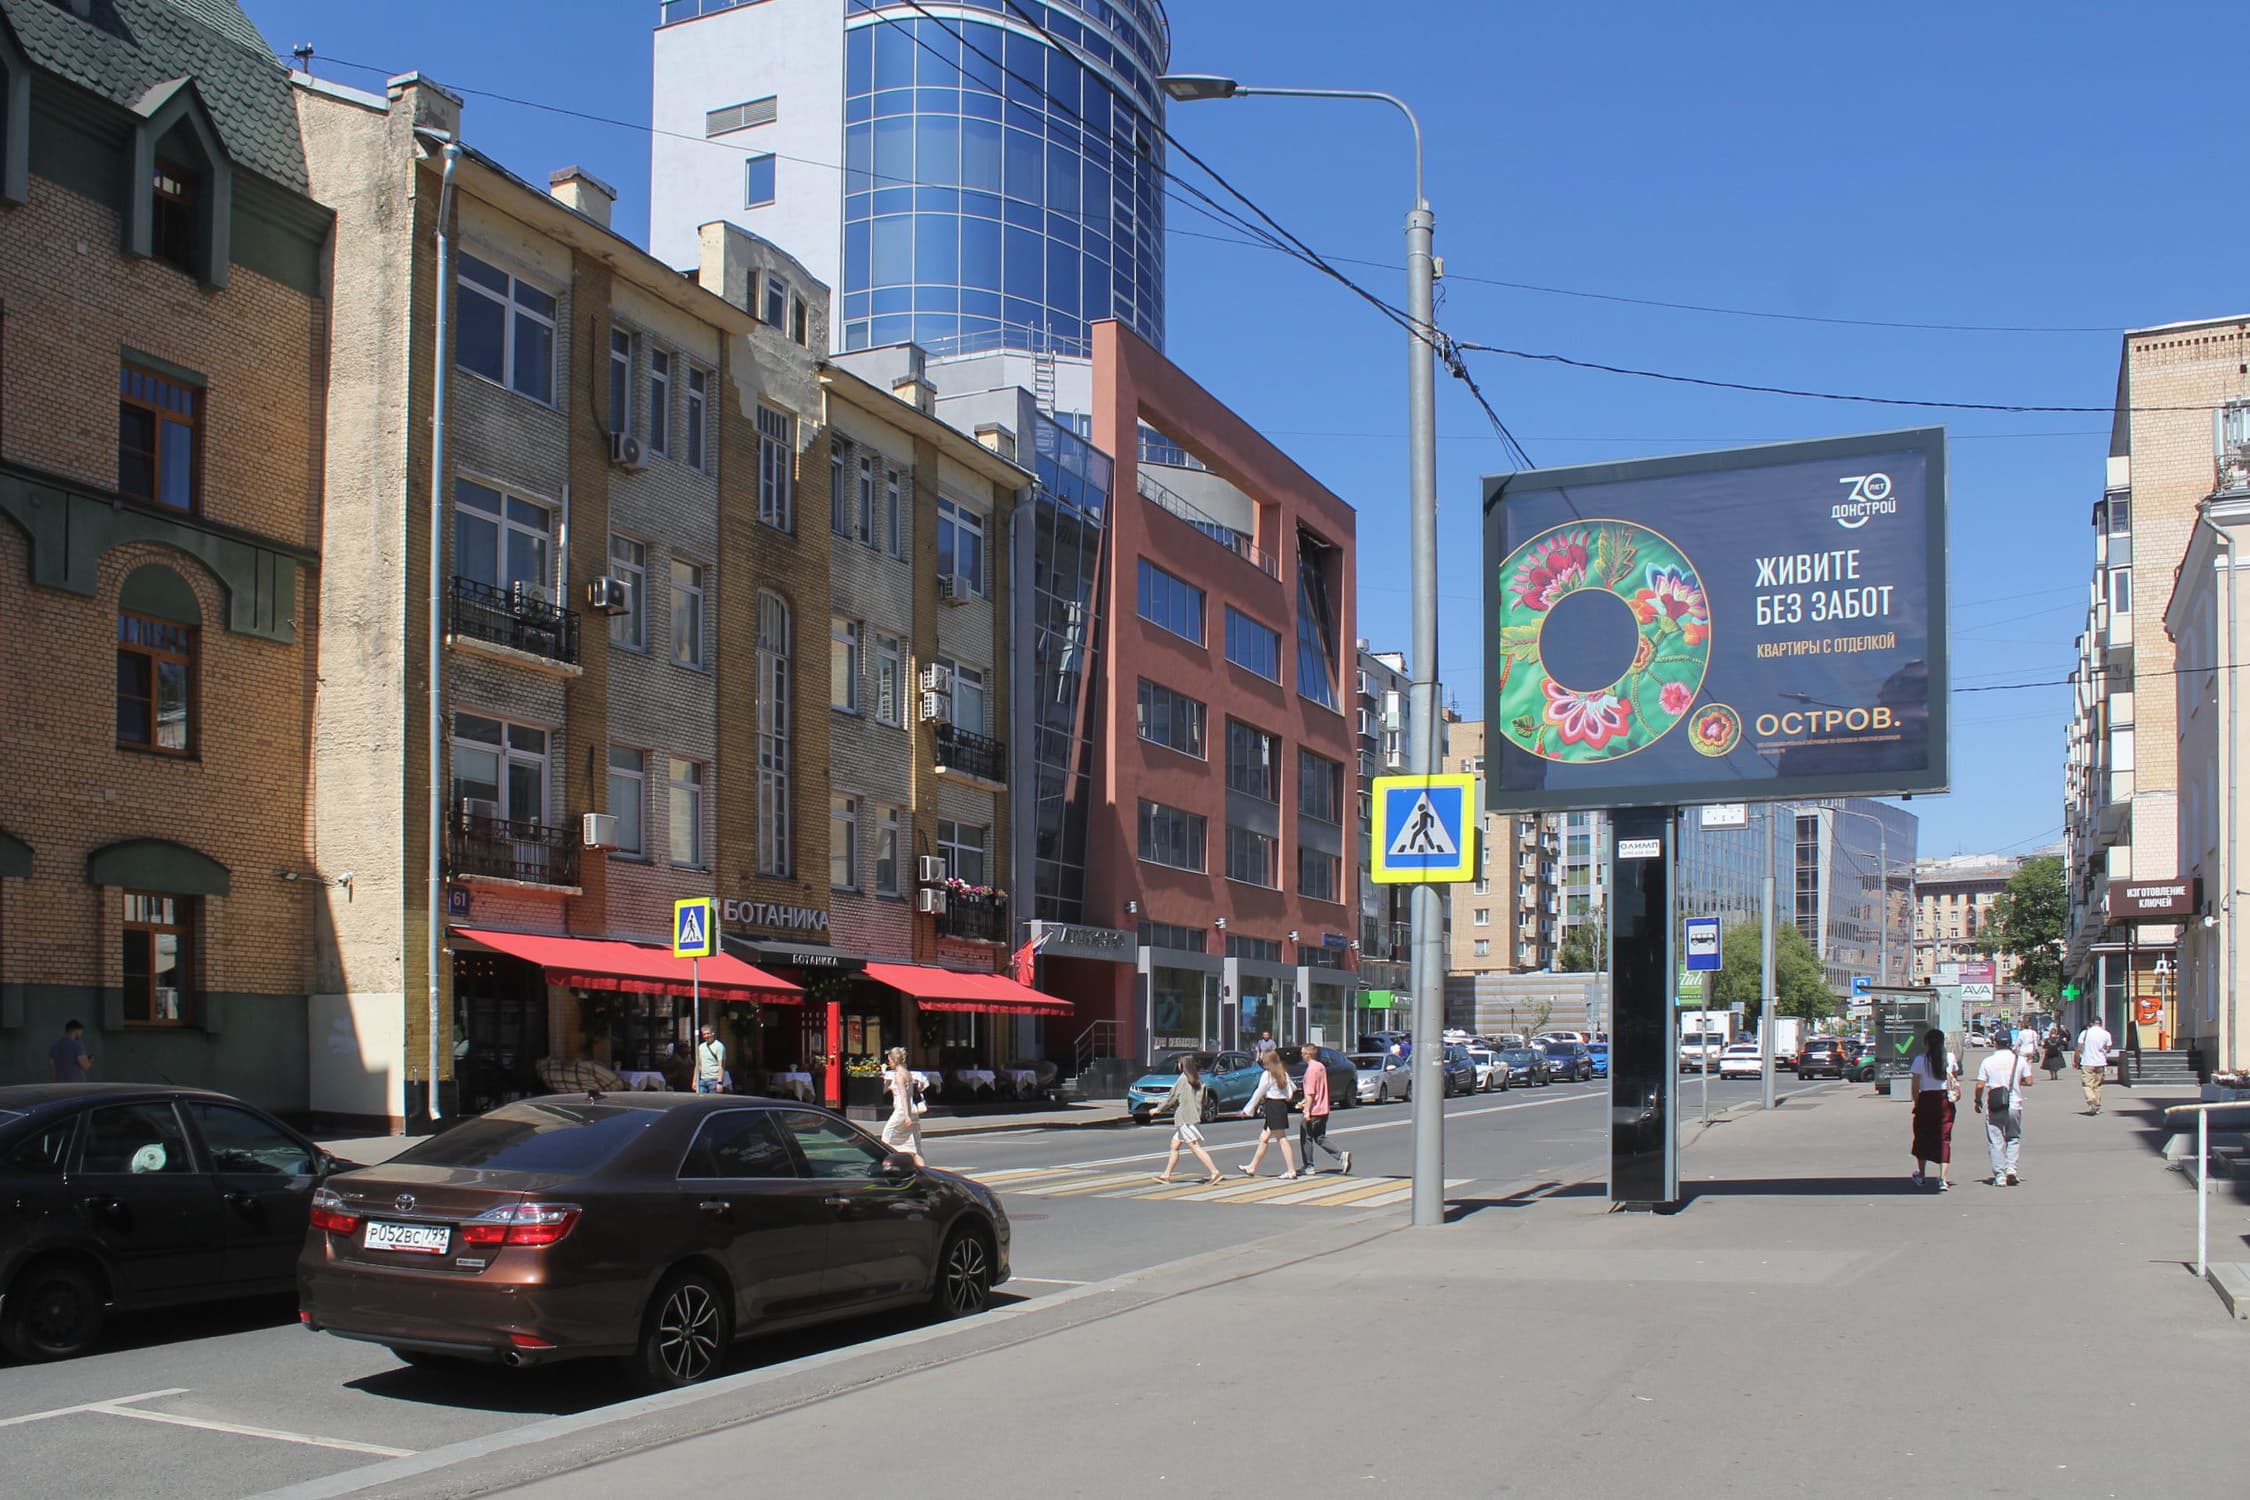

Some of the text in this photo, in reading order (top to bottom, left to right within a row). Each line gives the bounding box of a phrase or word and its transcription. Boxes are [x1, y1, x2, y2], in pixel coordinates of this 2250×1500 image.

[1830, 496, 1897, 519] ДОНСТРОЙ
[1754, 549, 1860, 588] ЖИВИТЕ
[1756, 585, 1894, 627] БЕЗ ЗАБОТ
[1756, 631, 1896, 659] КВАРТИРЫ С ОТДЕЛКОЙ
[1755, 706, 1901, 737] ОСТРОВ.
[1620, 842, 1658, 850] ОЛИМП
[453, 891, 467, 907] 61
[2126, 885, 2187, 898] ИЗГОТОВЛЕНИЕ
[2138, 896, 2173, 908] КЛЮЧЕЙ
[722, 898, 831, 932] БОТАНИКА
[791, 953, 839, 967] БОТАНИКА
[1962, 984, 1992, 996] AVA
[424, 1227, 447, 1241] 799
